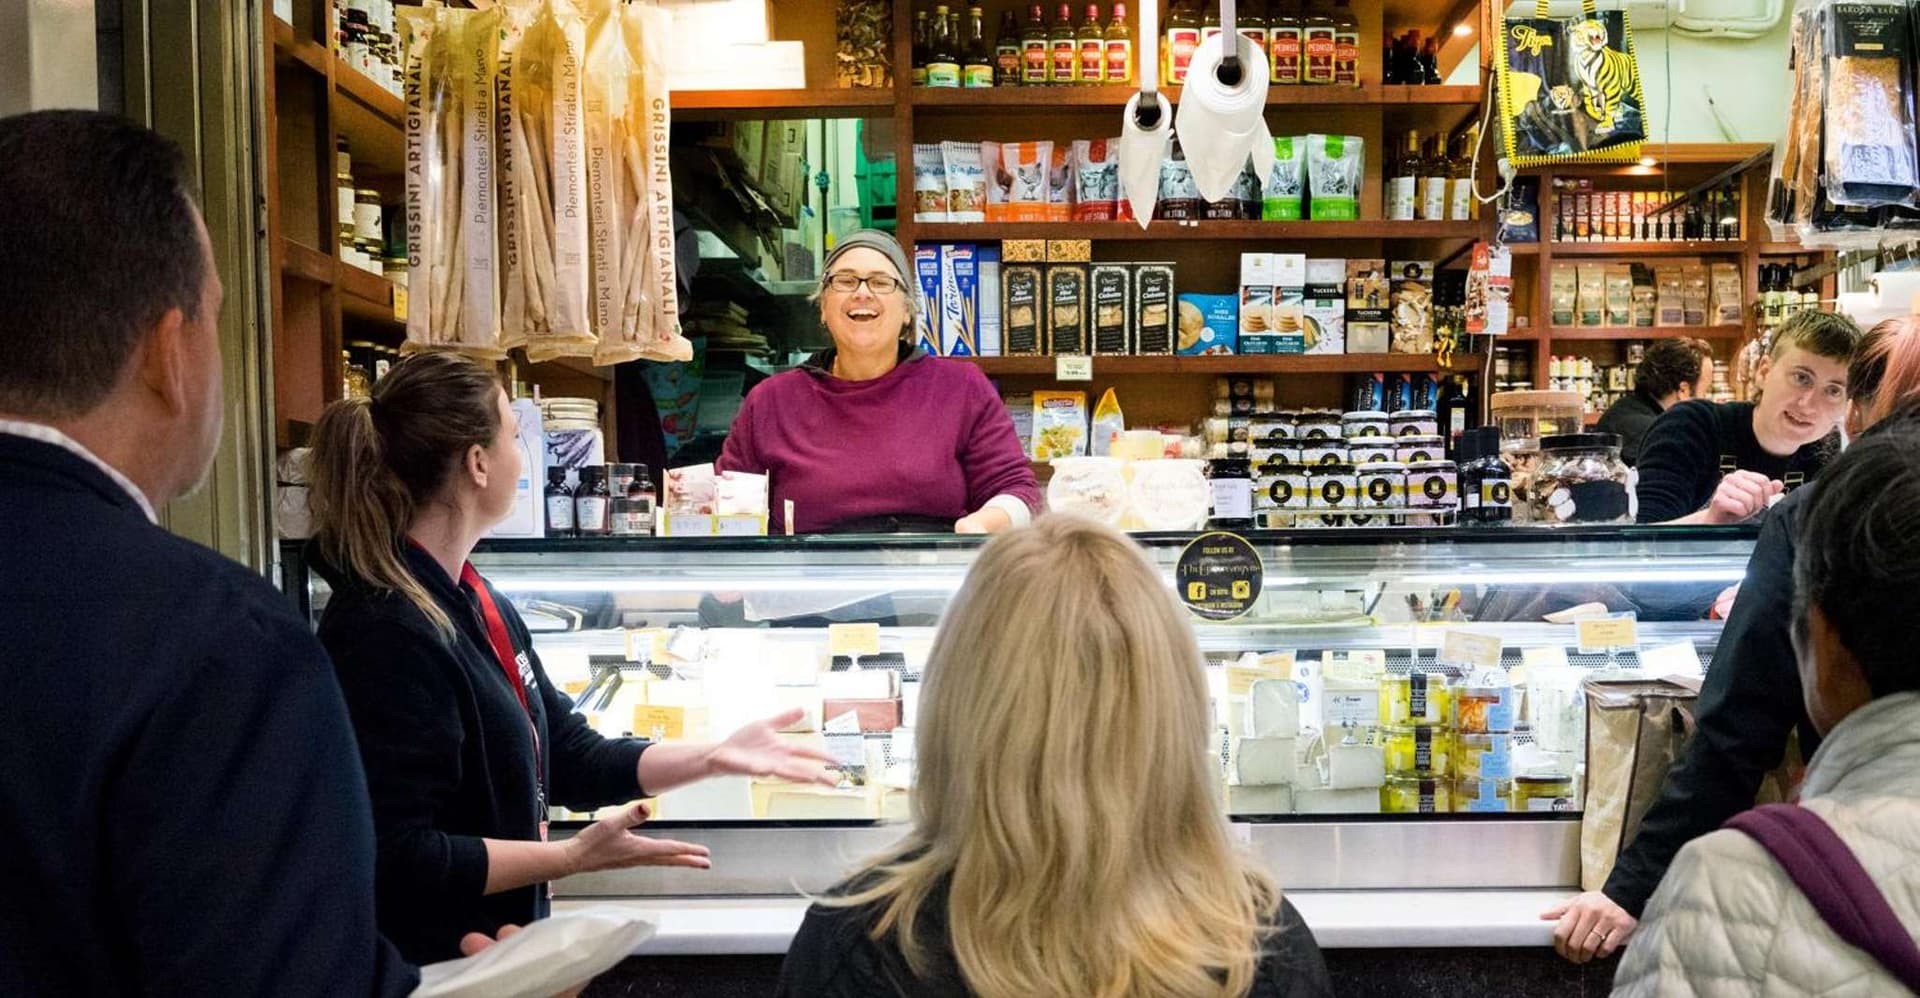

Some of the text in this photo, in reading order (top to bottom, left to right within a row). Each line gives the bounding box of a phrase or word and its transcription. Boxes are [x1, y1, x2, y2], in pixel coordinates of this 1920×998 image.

[563, 40, 576, 77] Mano
[473, 48, 488, 224] Piemontesi Stirati a Mano
[563, 93, 577, 135] Stirati
[408, 54, 422, 268] GRISSINI ARTIGIANALI
[564, 140, 578, 218] Piemontesi
[591, 147, 608, 225] Piemontesi
[653, 98, 676, 315] GRISSINI ARTIGIANALI
[595, 229, 609, 271] Stirati
[599, 287, 611, 326] Mano
